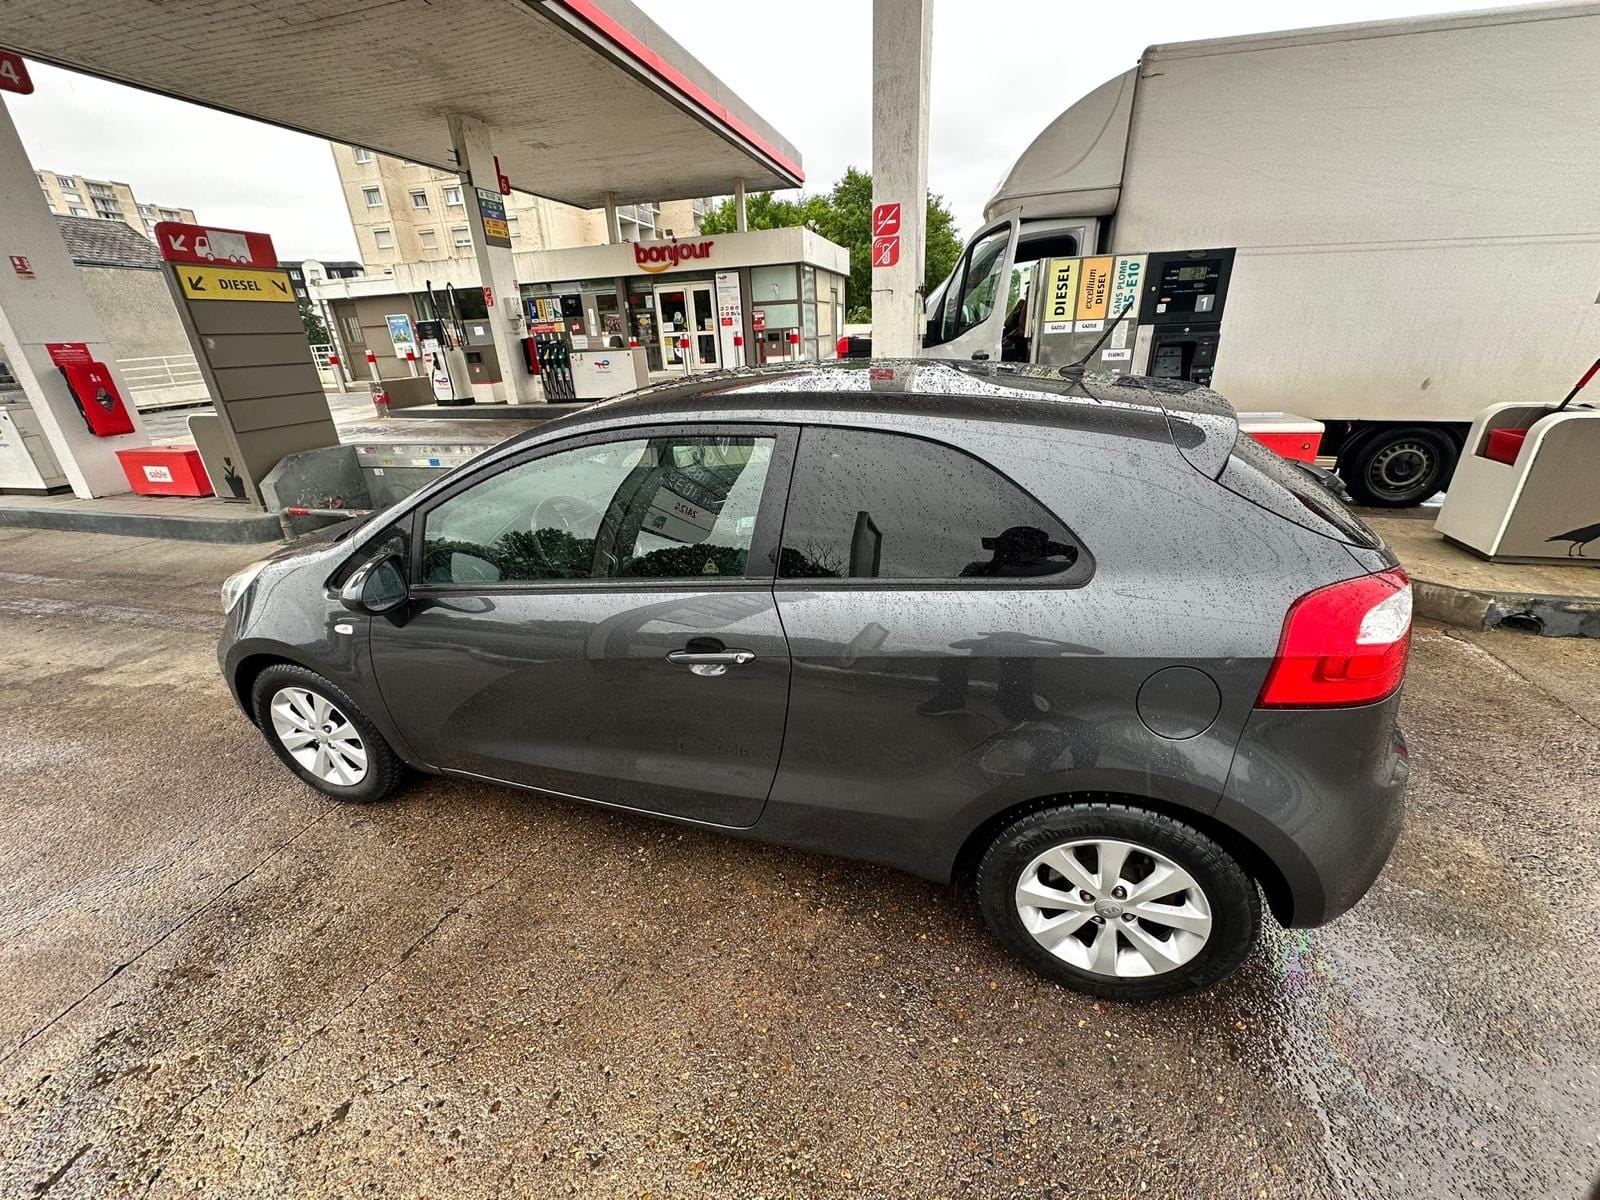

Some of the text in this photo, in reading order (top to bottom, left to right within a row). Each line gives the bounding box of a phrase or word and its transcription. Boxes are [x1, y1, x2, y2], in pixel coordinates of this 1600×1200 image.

[0, 59, 21, 85] 4
[500, 178, 508, 191] 6
[633, 237, 714, 266] bonjour
[218, 278, 262, 291] DIESEL
[1095, 272, 1107, 305] DIESEL
[1117, 260, 1128, 290] PLOMB
[1054, 264, 1071, 316] DIESEL
[1085, 269, 1097, 309] excellium
[1113, 292, 1123, 315] SANS
[1201, 296, 1208, 310] 1
